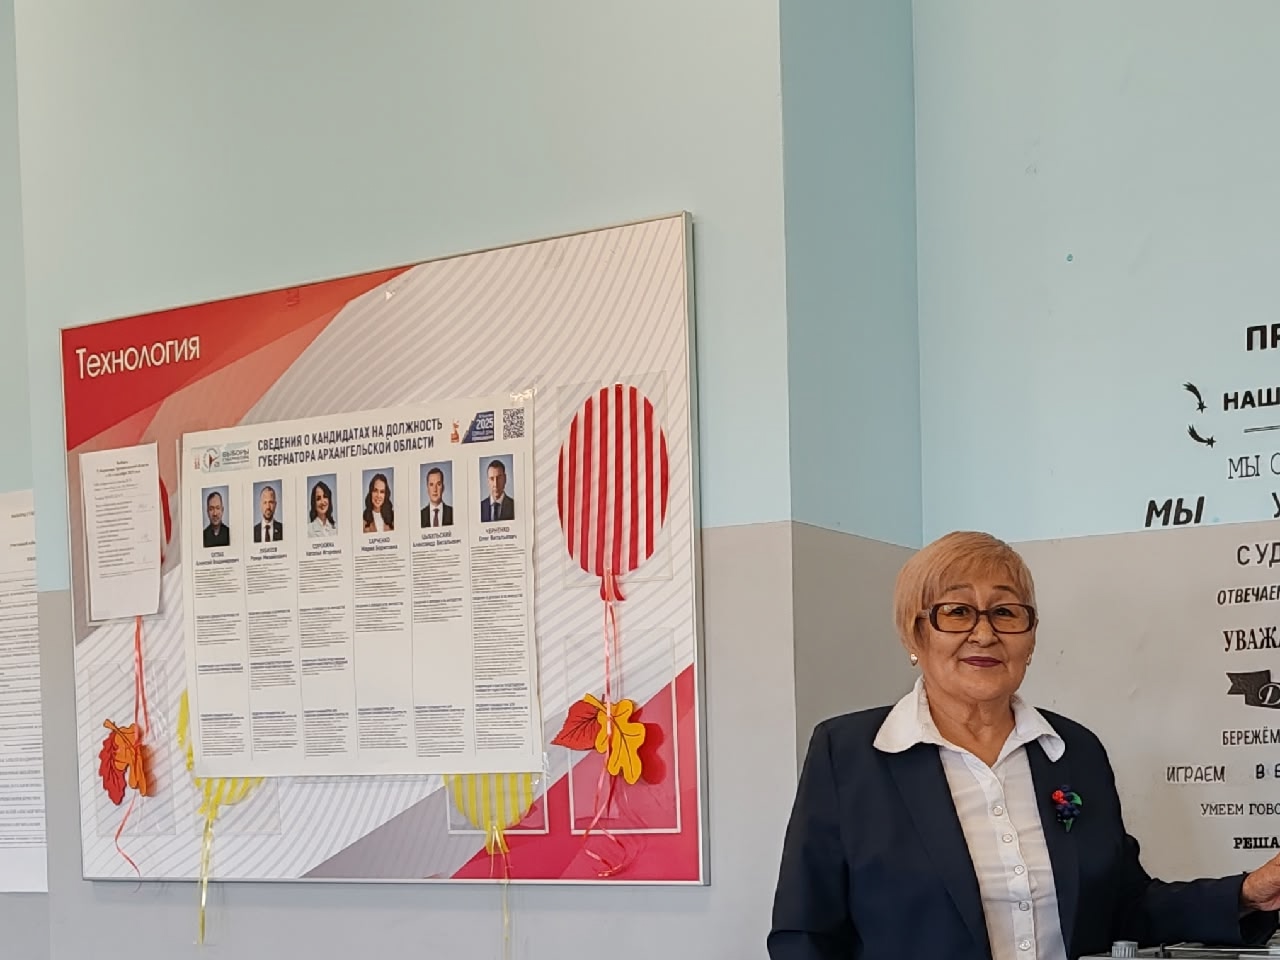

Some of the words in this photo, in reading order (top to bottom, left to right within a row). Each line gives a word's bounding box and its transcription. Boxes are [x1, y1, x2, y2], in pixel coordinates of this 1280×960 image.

[76, 335, 200, 380] Технология
[258, 434, 302, 451] СВЕДЕНИЯ
[304, 436, 310, 445] О
[312, 426, 369, 446] КАНДИДАТАХ
[372, 424, 383, 438] НА
[386, 418, 442, 438] ДОЛЖНОСТЬ
[476, 418, 494, 430] 2025
[258, 450, 316, 467] ГУБЕРНАТОРА
[318, 437, 391, 461] АРХАНГЕЛЬСКОЙ
[394, 436, 434, 452] ОБЛАСТИ
[1228, 455, 1260, 479] МЫ
[1145, 496, 1205, 528] МЫ
[1237, 545, 1250, 565] С
[1222, 726, 1280, 746] БЕРЕЖЁМ
[1166, 765, 1226, 783] ИГРАЕМ
[1256, 764, 1265, 779] В
[1201, 803, 1244, 816] УМЕЕМ
